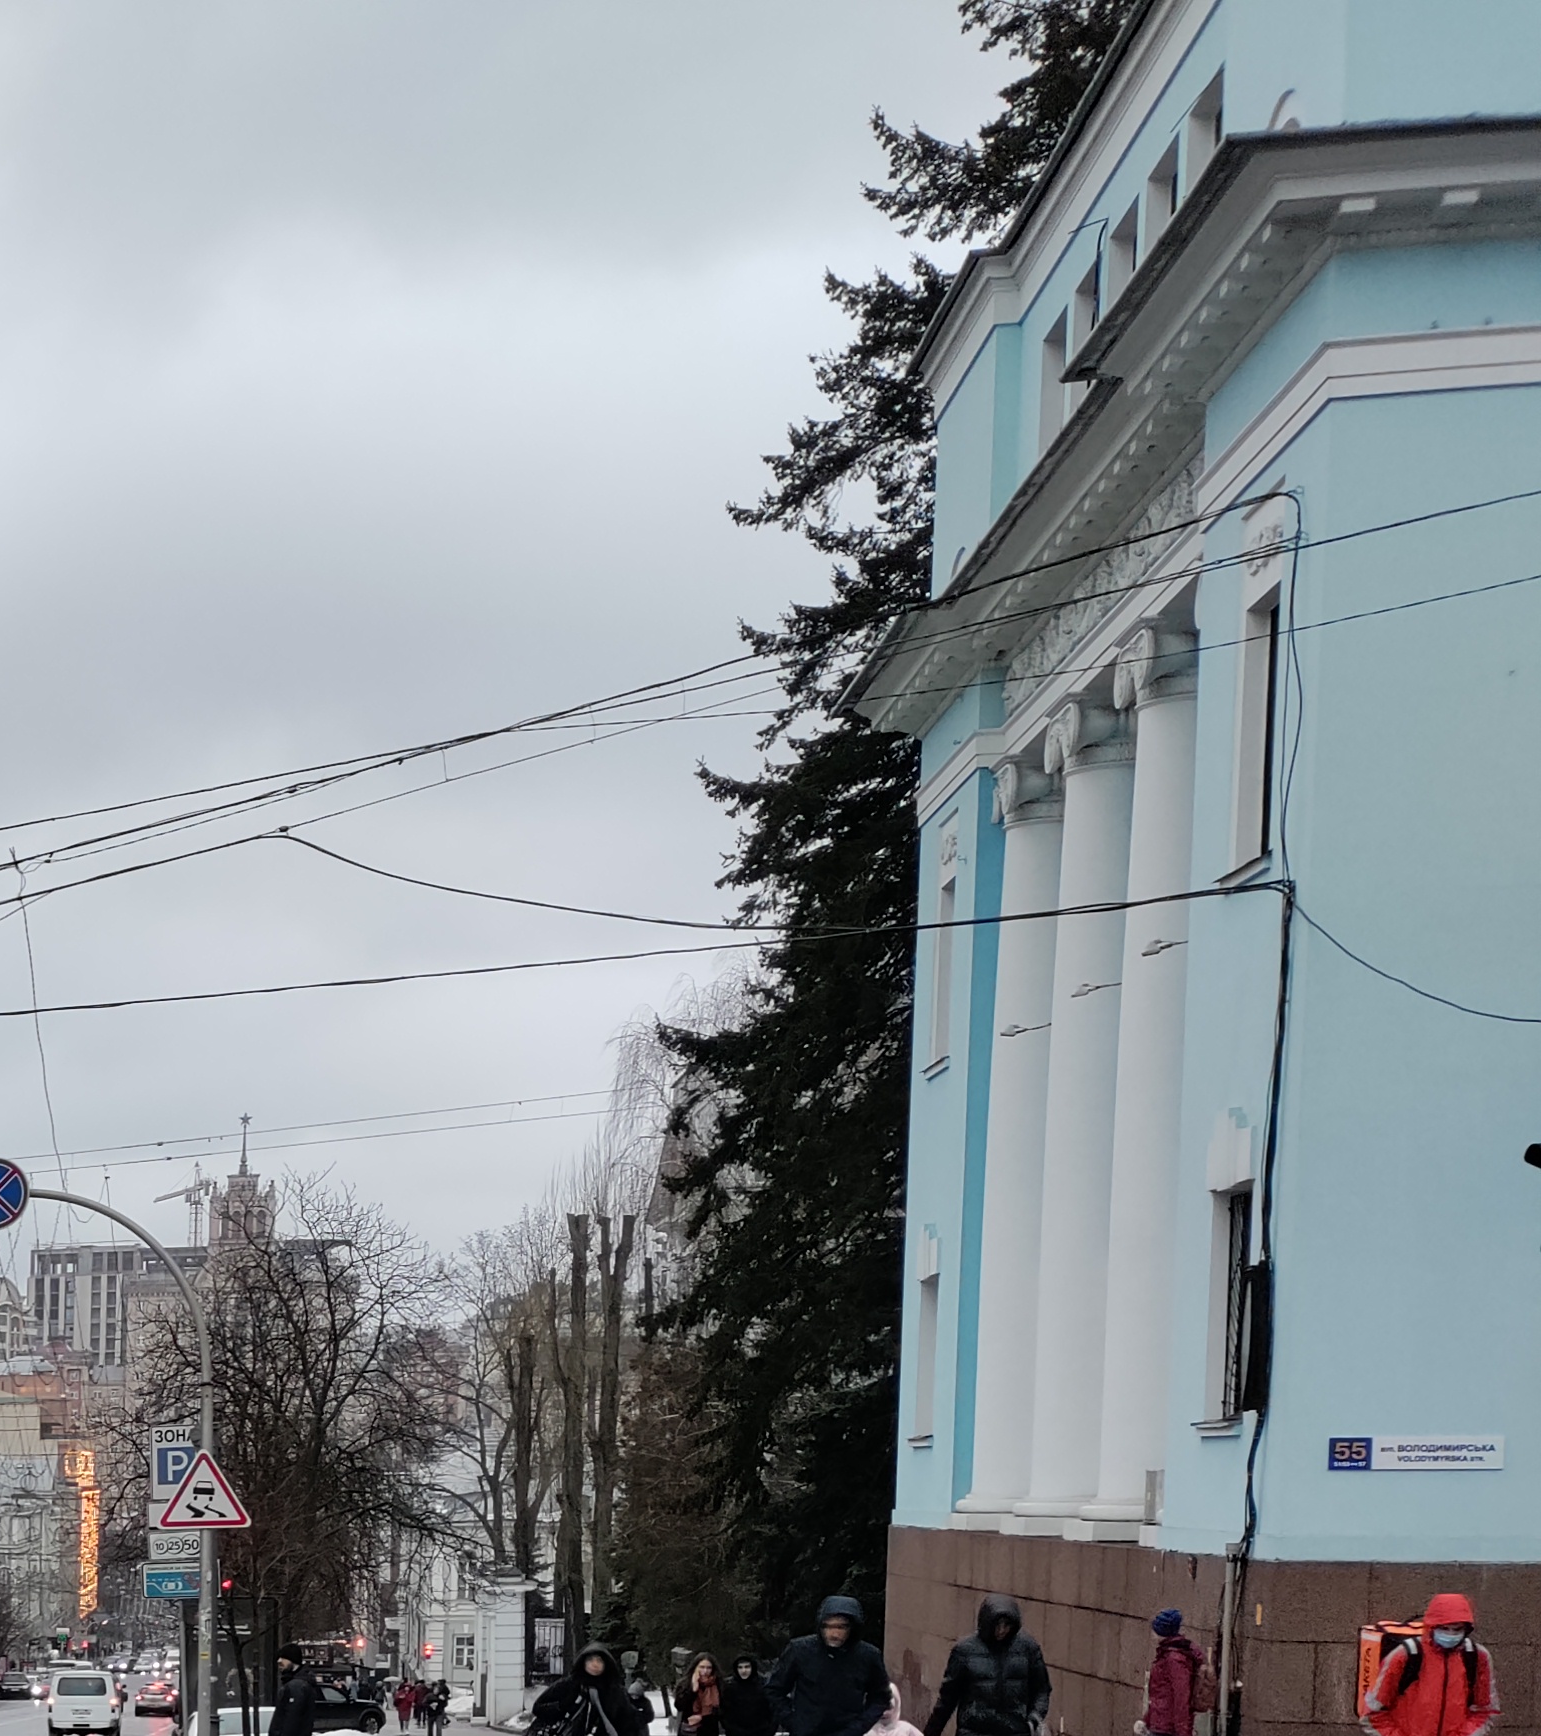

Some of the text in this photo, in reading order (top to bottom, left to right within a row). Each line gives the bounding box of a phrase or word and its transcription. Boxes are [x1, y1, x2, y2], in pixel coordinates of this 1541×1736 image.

[1334, 1442, 1367, 1460] 55
[1397, 1444, 1496, 1453] ВОЛОДИМИРСЬКА
[155, 1539, 200, 1551] 10 25 50
